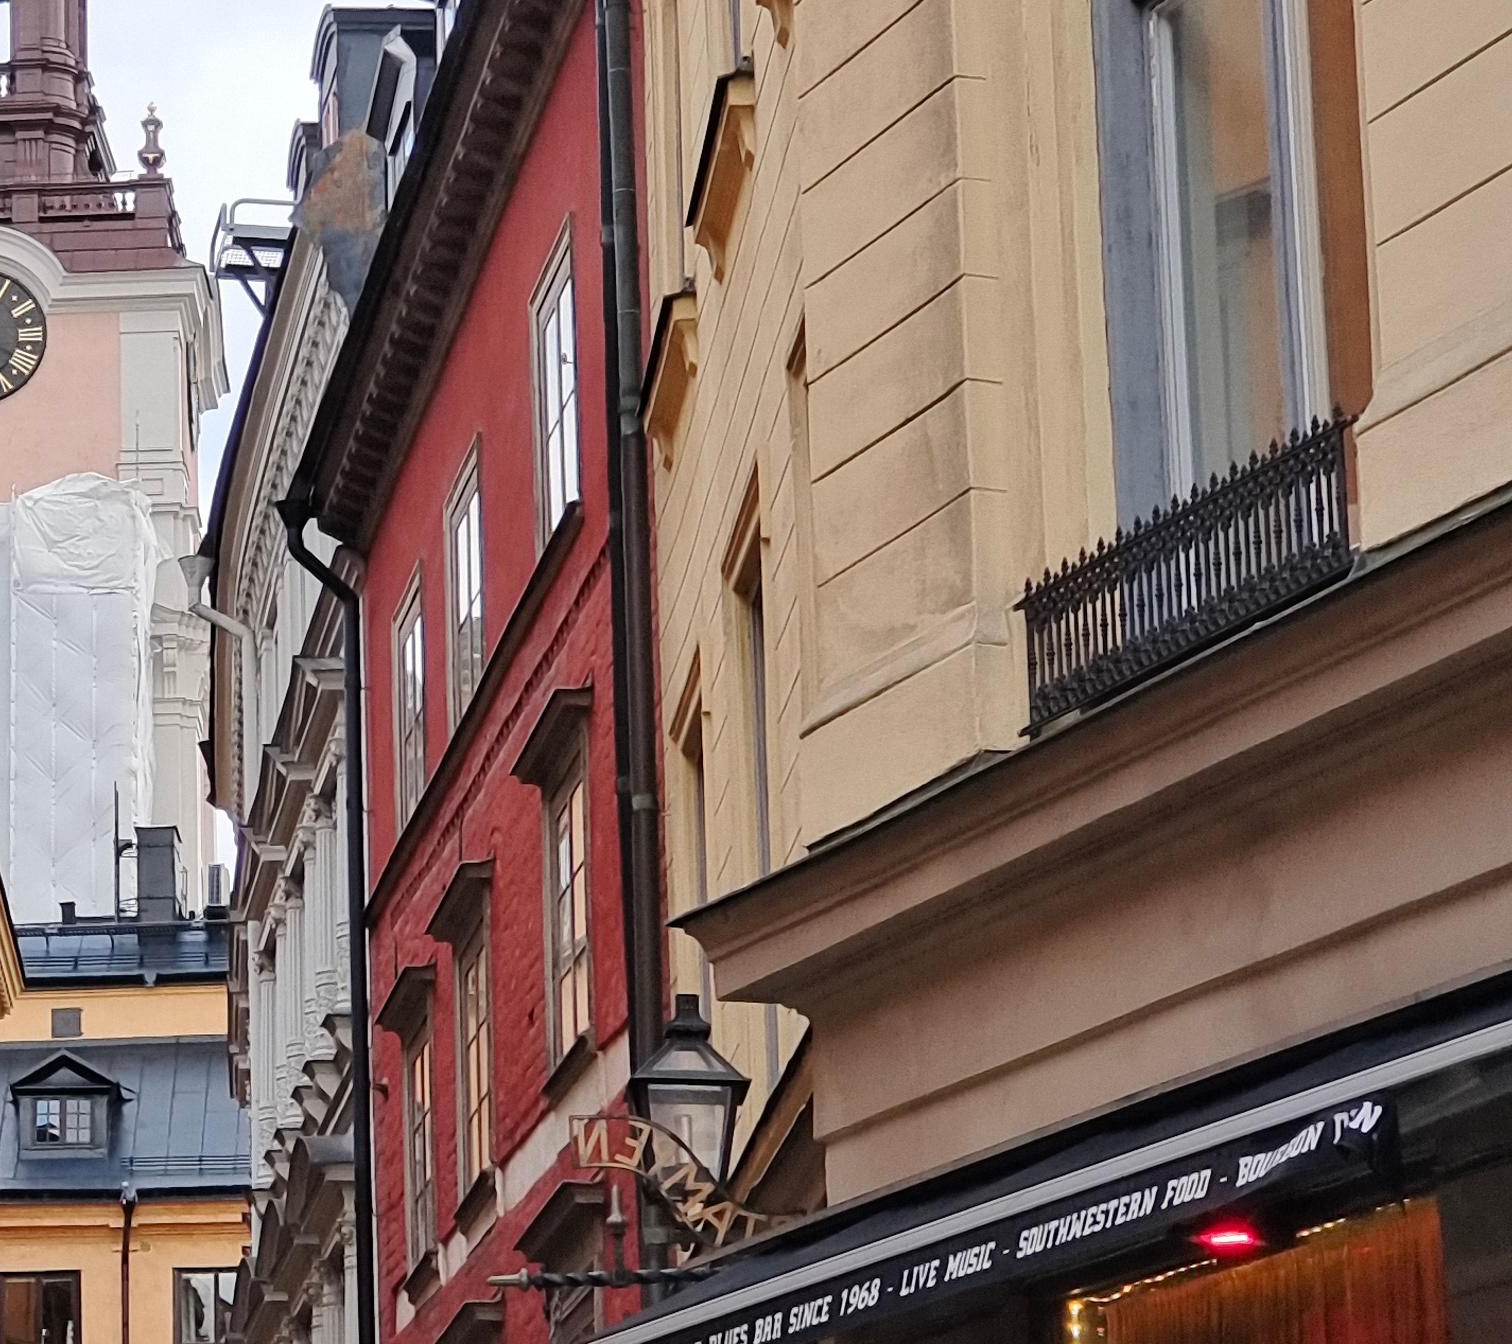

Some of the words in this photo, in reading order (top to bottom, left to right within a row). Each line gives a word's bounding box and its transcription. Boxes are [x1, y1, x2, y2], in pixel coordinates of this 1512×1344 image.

[11, 299, 36, 318] II
[18, 326, 43, 341] III
[9, 349, 38, 376] IIII
[788, 1295, 833, 1334] SINCE
[839, 1278, 881, 1317] 1968
[899, 1259, 940, 1296] LIVE
[944, 1241, 996, 1282] MUSIC
[1016, 1186, 1158, 1259] SOUTHWESTERN
[1161, 1168, 1212, 1209] FOOD
